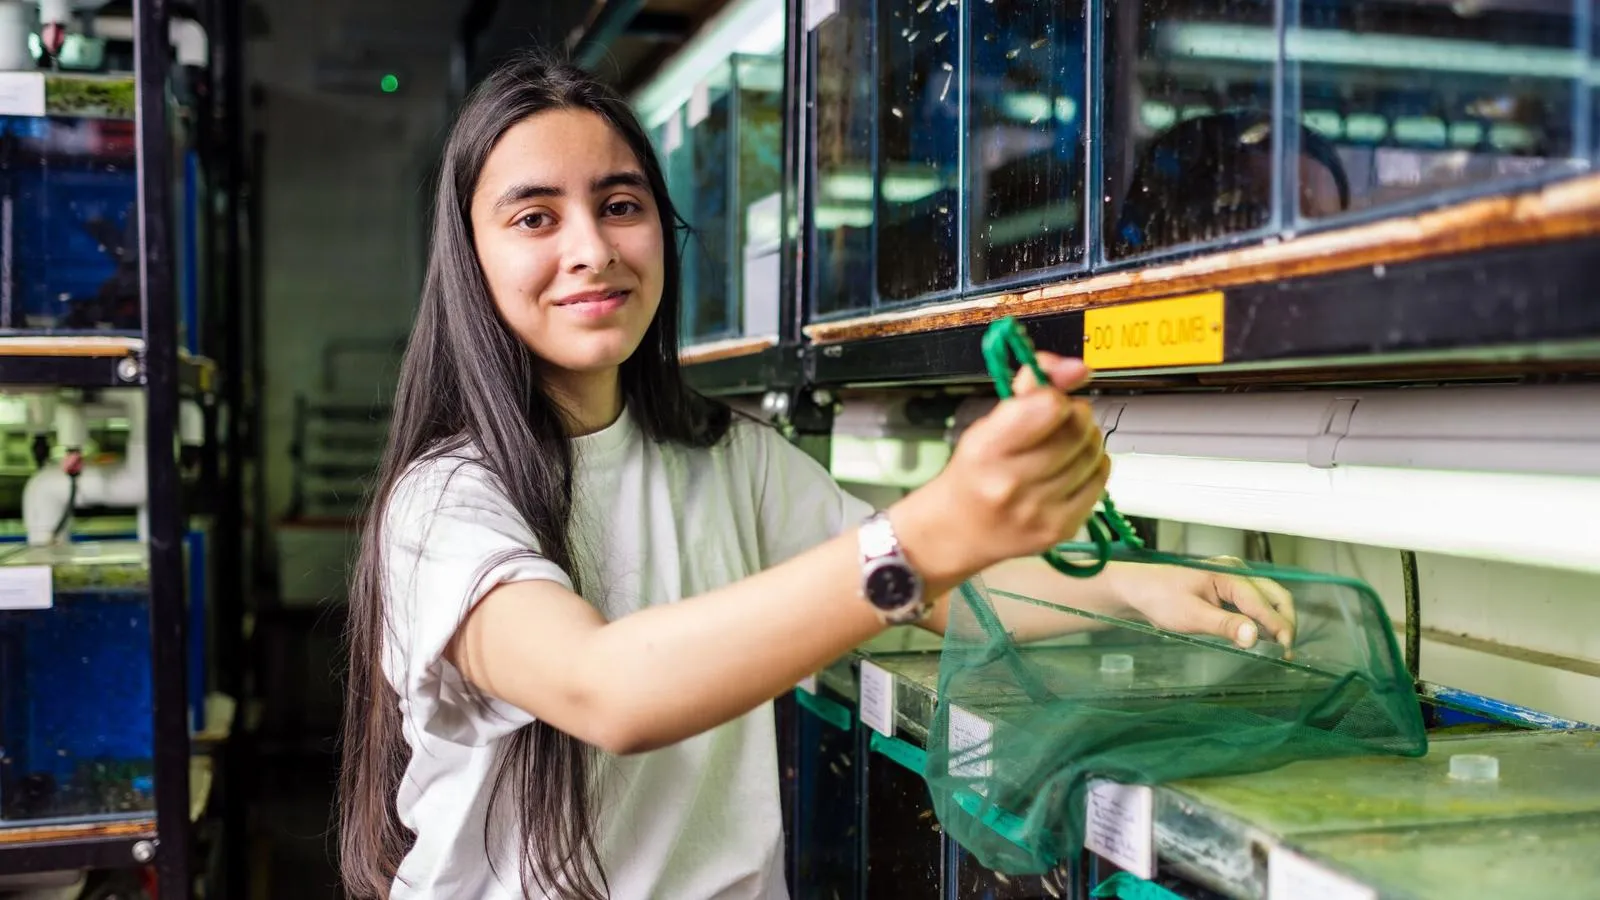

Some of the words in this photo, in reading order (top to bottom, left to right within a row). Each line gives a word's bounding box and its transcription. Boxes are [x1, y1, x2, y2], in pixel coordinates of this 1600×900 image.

[1094, 325, 1113, 350] DO
[1121, 321, 1149, 347] NOT
[1157, 316, 1205, 346] CLIMB
